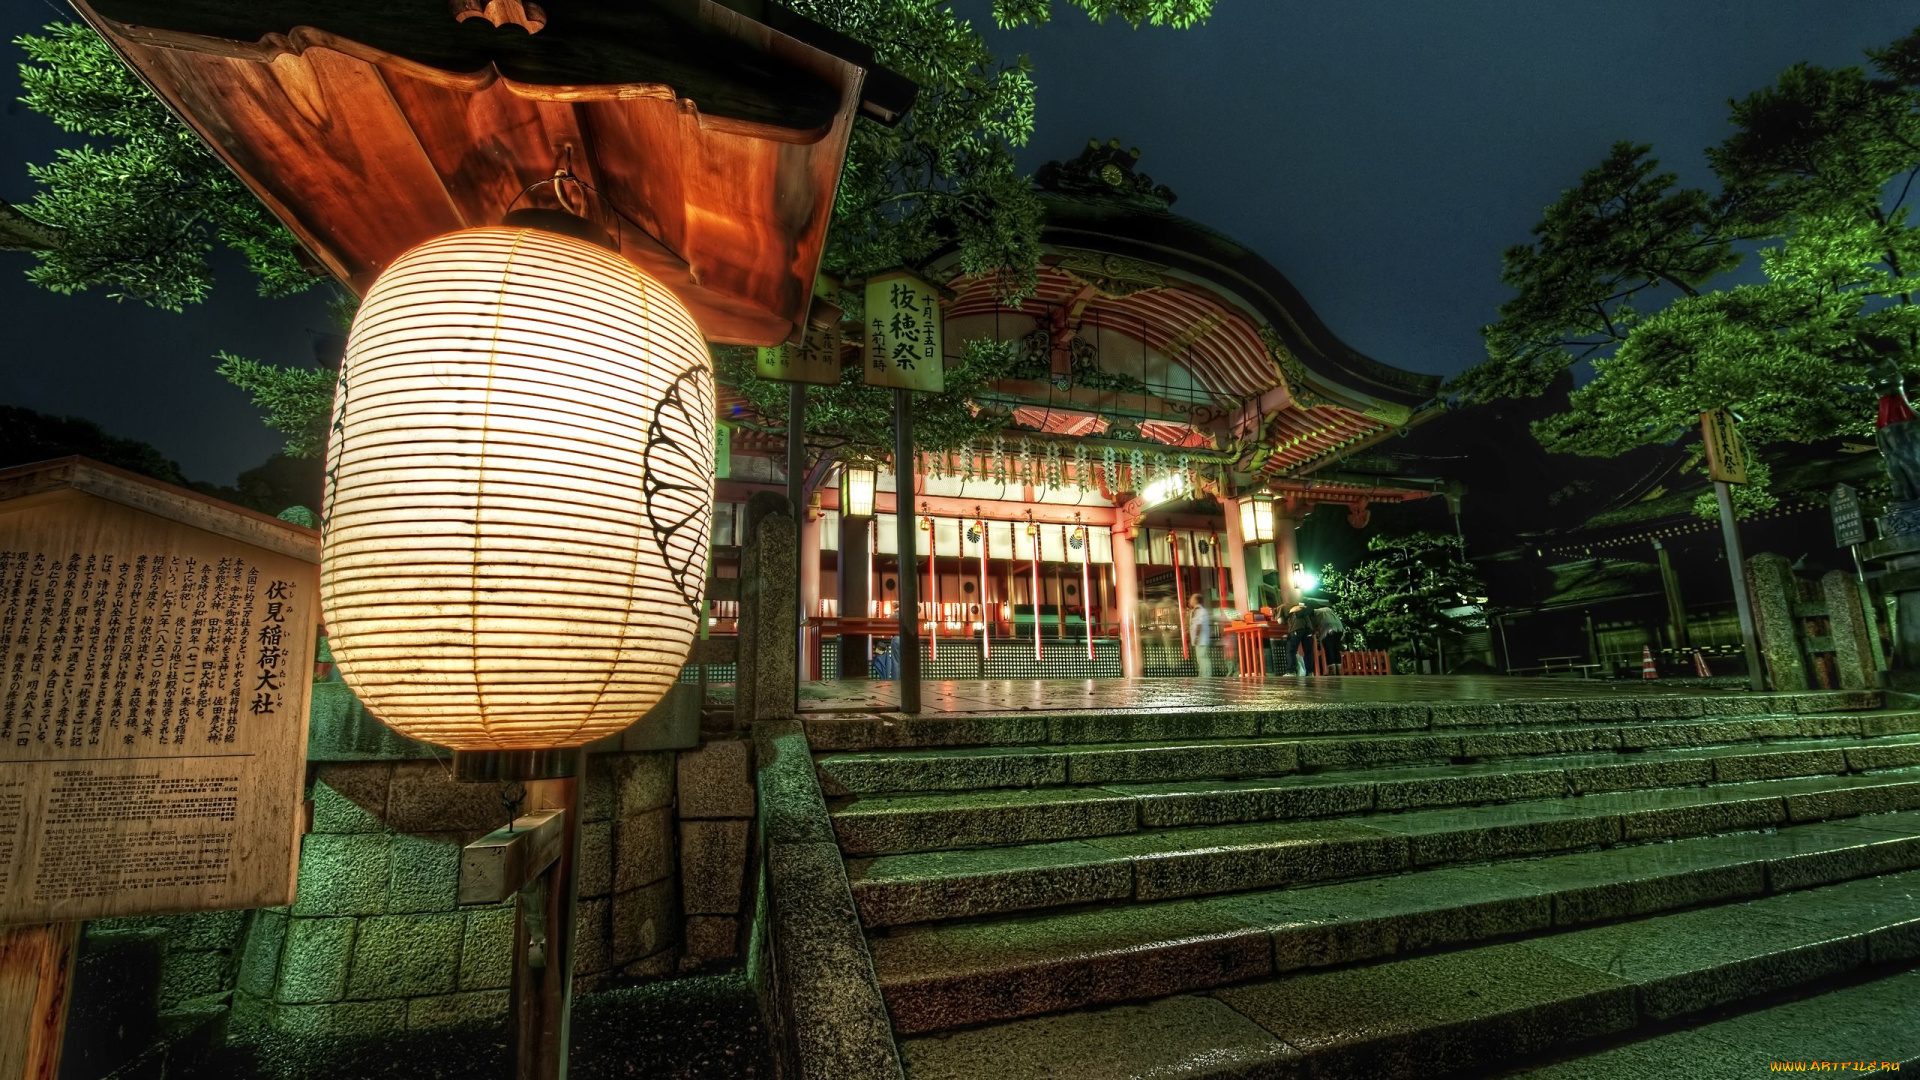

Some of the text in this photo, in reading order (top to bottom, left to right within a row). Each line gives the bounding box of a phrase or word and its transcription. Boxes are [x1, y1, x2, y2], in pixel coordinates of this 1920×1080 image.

[795, 329, 821, 361] 祭
[822, 332, 834, 365] 午後一時
[871, 318, 888, 373] 午前十一時
[888, 283, 932, 371] 抜穂祭
[921, 294, 937, 358] 十月二十五日
[765, 348, 775, 366] 六時
[249, 580, 288, 716] 伏見稲荷大社
